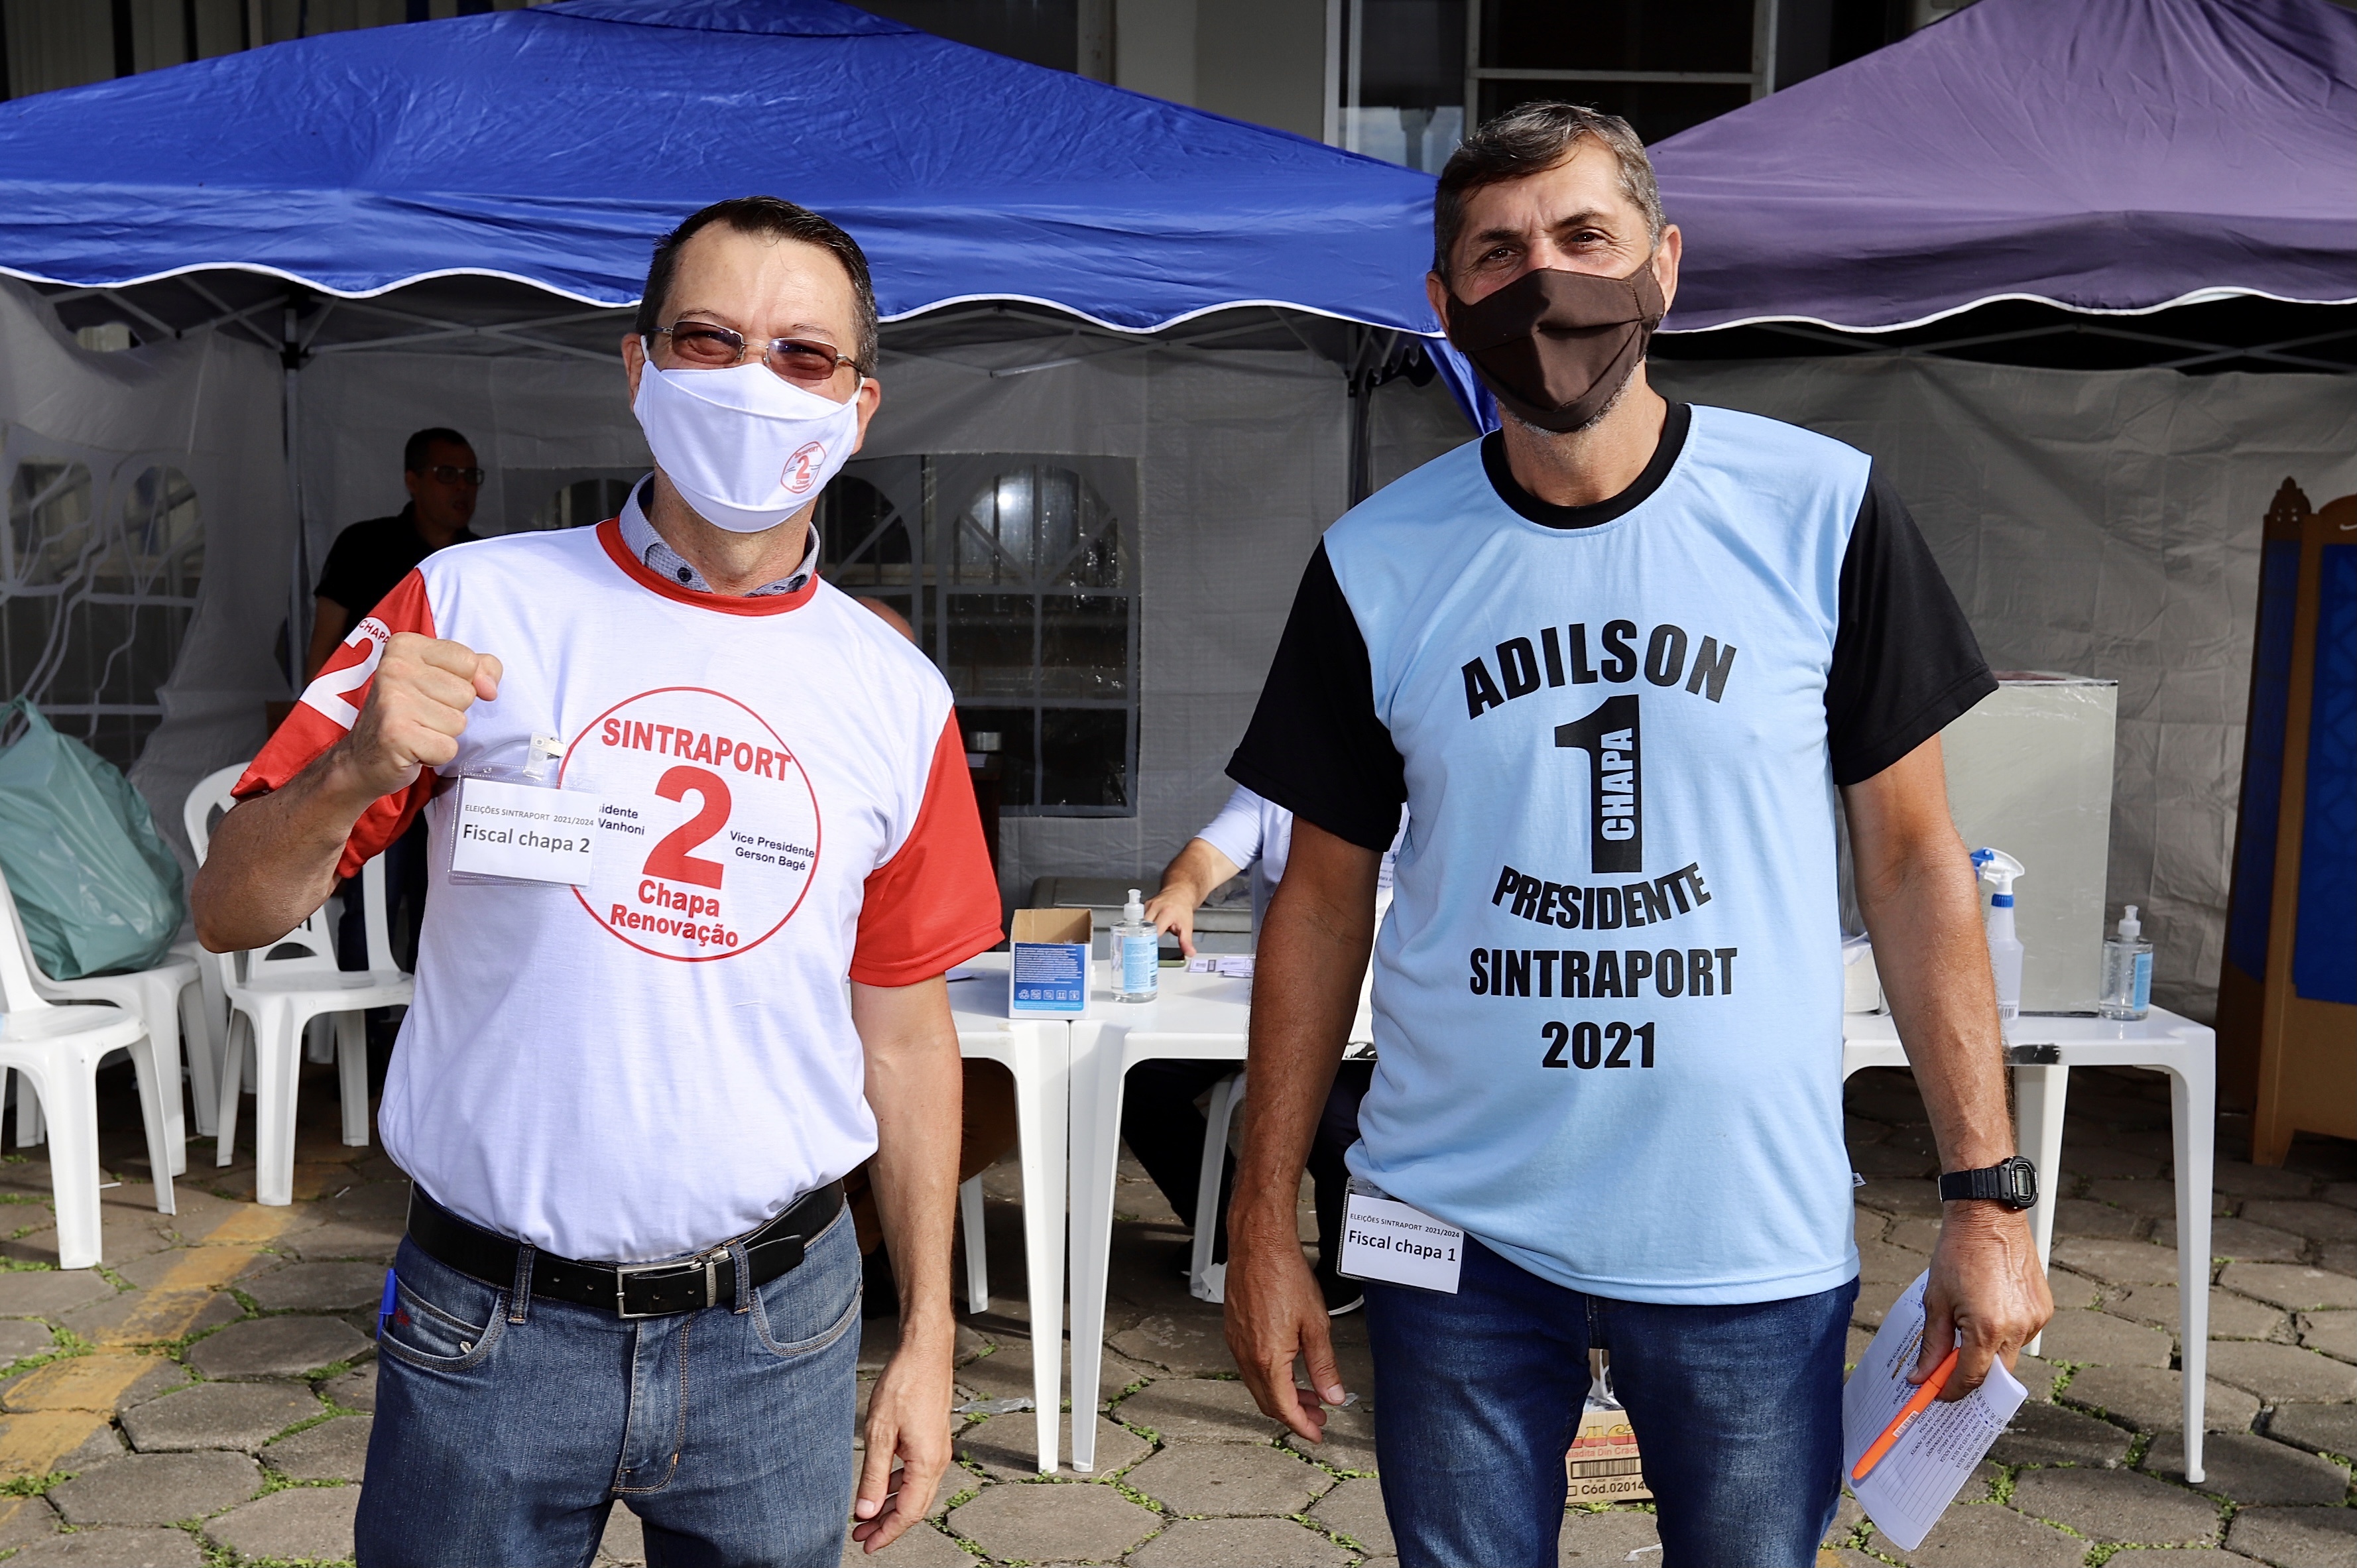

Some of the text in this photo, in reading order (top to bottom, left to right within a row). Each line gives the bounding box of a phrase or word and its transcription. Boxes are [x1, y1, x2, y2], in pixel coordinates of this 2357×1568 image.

[796, 455, 810, 479] 2
[299, 617, 391, 731] 2
[1461, 619, 1737, 720] ADILSON
[601, 718, 792, 781] SINTRAPORT
[1554, 694, 1642, 874] 1
[1601, 727, 1635, 841] CHAPA
[465, 804, 594, 826] ELEIÇÕES SINTRAPORT 2021/2024
[598, 817, 645, 835] Vanhoni
[642, 765, 731, 890] 2
[463, 823, 590, 853] Fiscal chapa 2
[730, 830, 815, 858] Vice Presidente
[735, 847, 806, 871] Gerson Bagé
[638, 879, 720, 918] Chapa
[1491, 861, 1711, 930] PRESIDENTE
[610, 904, 739, 947] Renovação
[1469, 947, 1738, 998] SINTRAPORT
[1541, 1021, 1655, 1069] 2021
[1350, 1213, 1460, 1238] ELEIÇÕES SINTRAPORT 2021/2024
[1349, 1230, 1456, 1262] Fiscal chapa 1
[1892, 1343, 1902, 1358] SANTOS
[1907, 1353, 1916, 1366] COSTA
[1917, 1411, 1927, 1424] COSTA
[1933, 1406, 1949, 1426] FRANCISCA
[1963, 1406, 1972, 1419] SONIA
[1919, 1422, 1927, 1433] ROSA
[1921, 1425, 1933, 1440] MIGUEL
[1970, 1419, 1981, 1433] SIDNEY
[1972, 1425, 1987, 1444] SEVERINO
[1982, 1429, 1994, 1443] SERGIO
[1910, 1439, 1922, 1455] PONTES
[1925, 1427, 1940, 1447] MARIANO
[1925, 1435, 1943, 1457] FERNANDES
[1937, 1437, 1949, 1454] ARAUJO
[1949, 1431, 1962, 1449] SIQUEIRA
[1962, 1432, 1971, 1445] ALVES
[1566, 1446, 1640, 1458] aladita Din Crack
[1940, 1449, 1950, 1462] SOUZA
[1951, 1449, 1959, 1460] SILVA
[1966, 1443, 1974, 1452] JOSE
[1955, 1457, 1964, 1468] SILVA
[1963, 1451, 1979, 1471] MONTEIRO
[1581, 1481, 1648, 1494] Cód.02014
